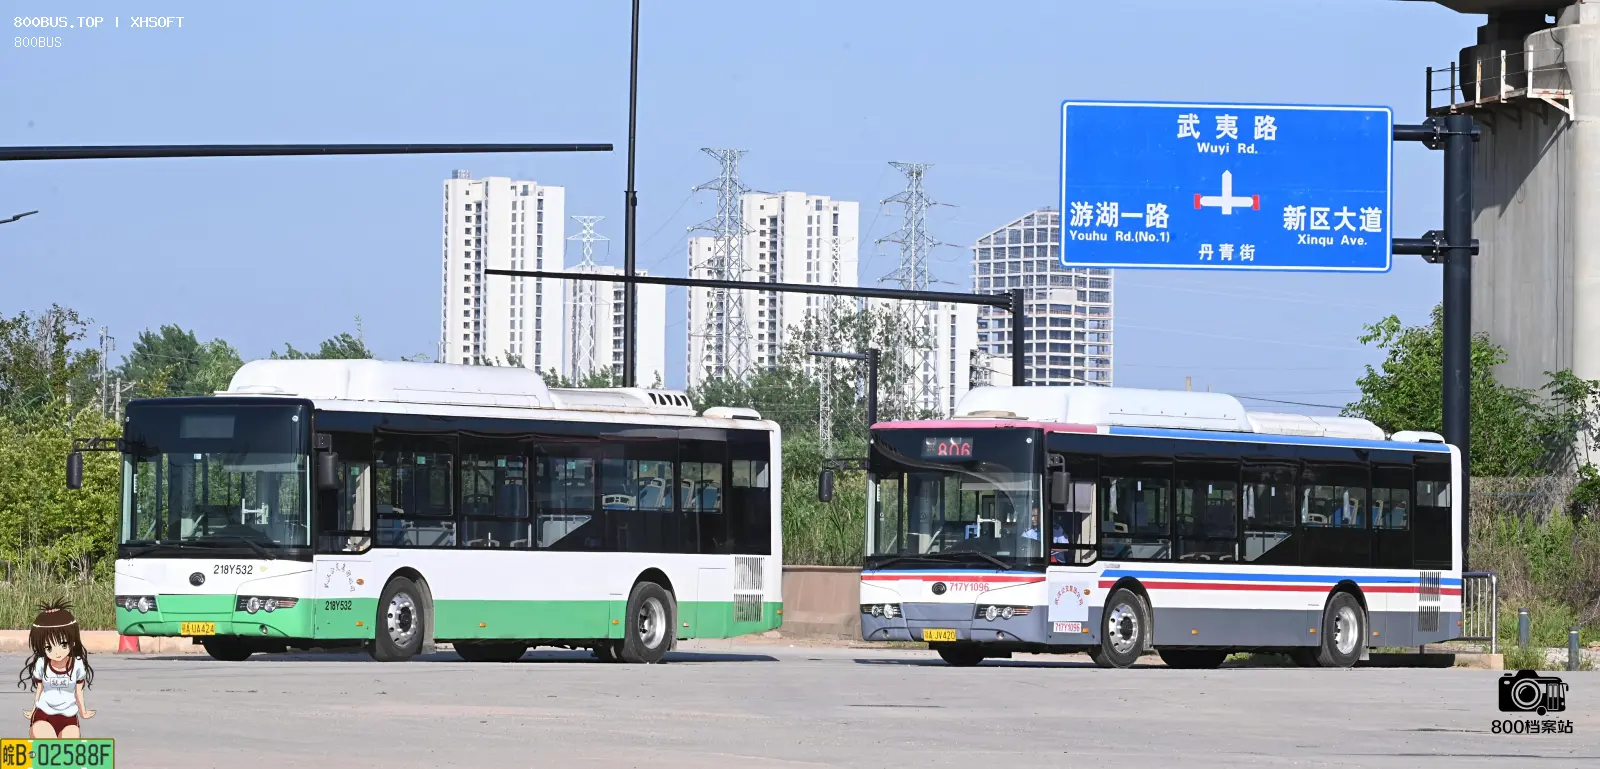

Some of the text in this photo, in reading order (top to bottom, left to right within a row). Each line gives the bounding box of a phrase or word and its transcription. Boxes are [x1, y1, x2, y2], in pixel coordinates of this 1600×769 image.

[1197, 142, 1258, 155] Wuyi Rd.
[1069, 201, 1170, 229] 游湖一路
[1283, 205, 1383, 232] 新区大道
[1069, 231, 1170, 244] Youhu Rd.(No.1)
[1297, 234, 1368, 247] Xinqu Ave.
[1198, 243, 1256, 262] 丹青街
[213, 564, 253, 575] 218Y532
[949, 582, 990, 592] 717Y1096
[325, 600, 352, 611] 218Y532
[1055, 622, 1080, 632] 717Y1096
